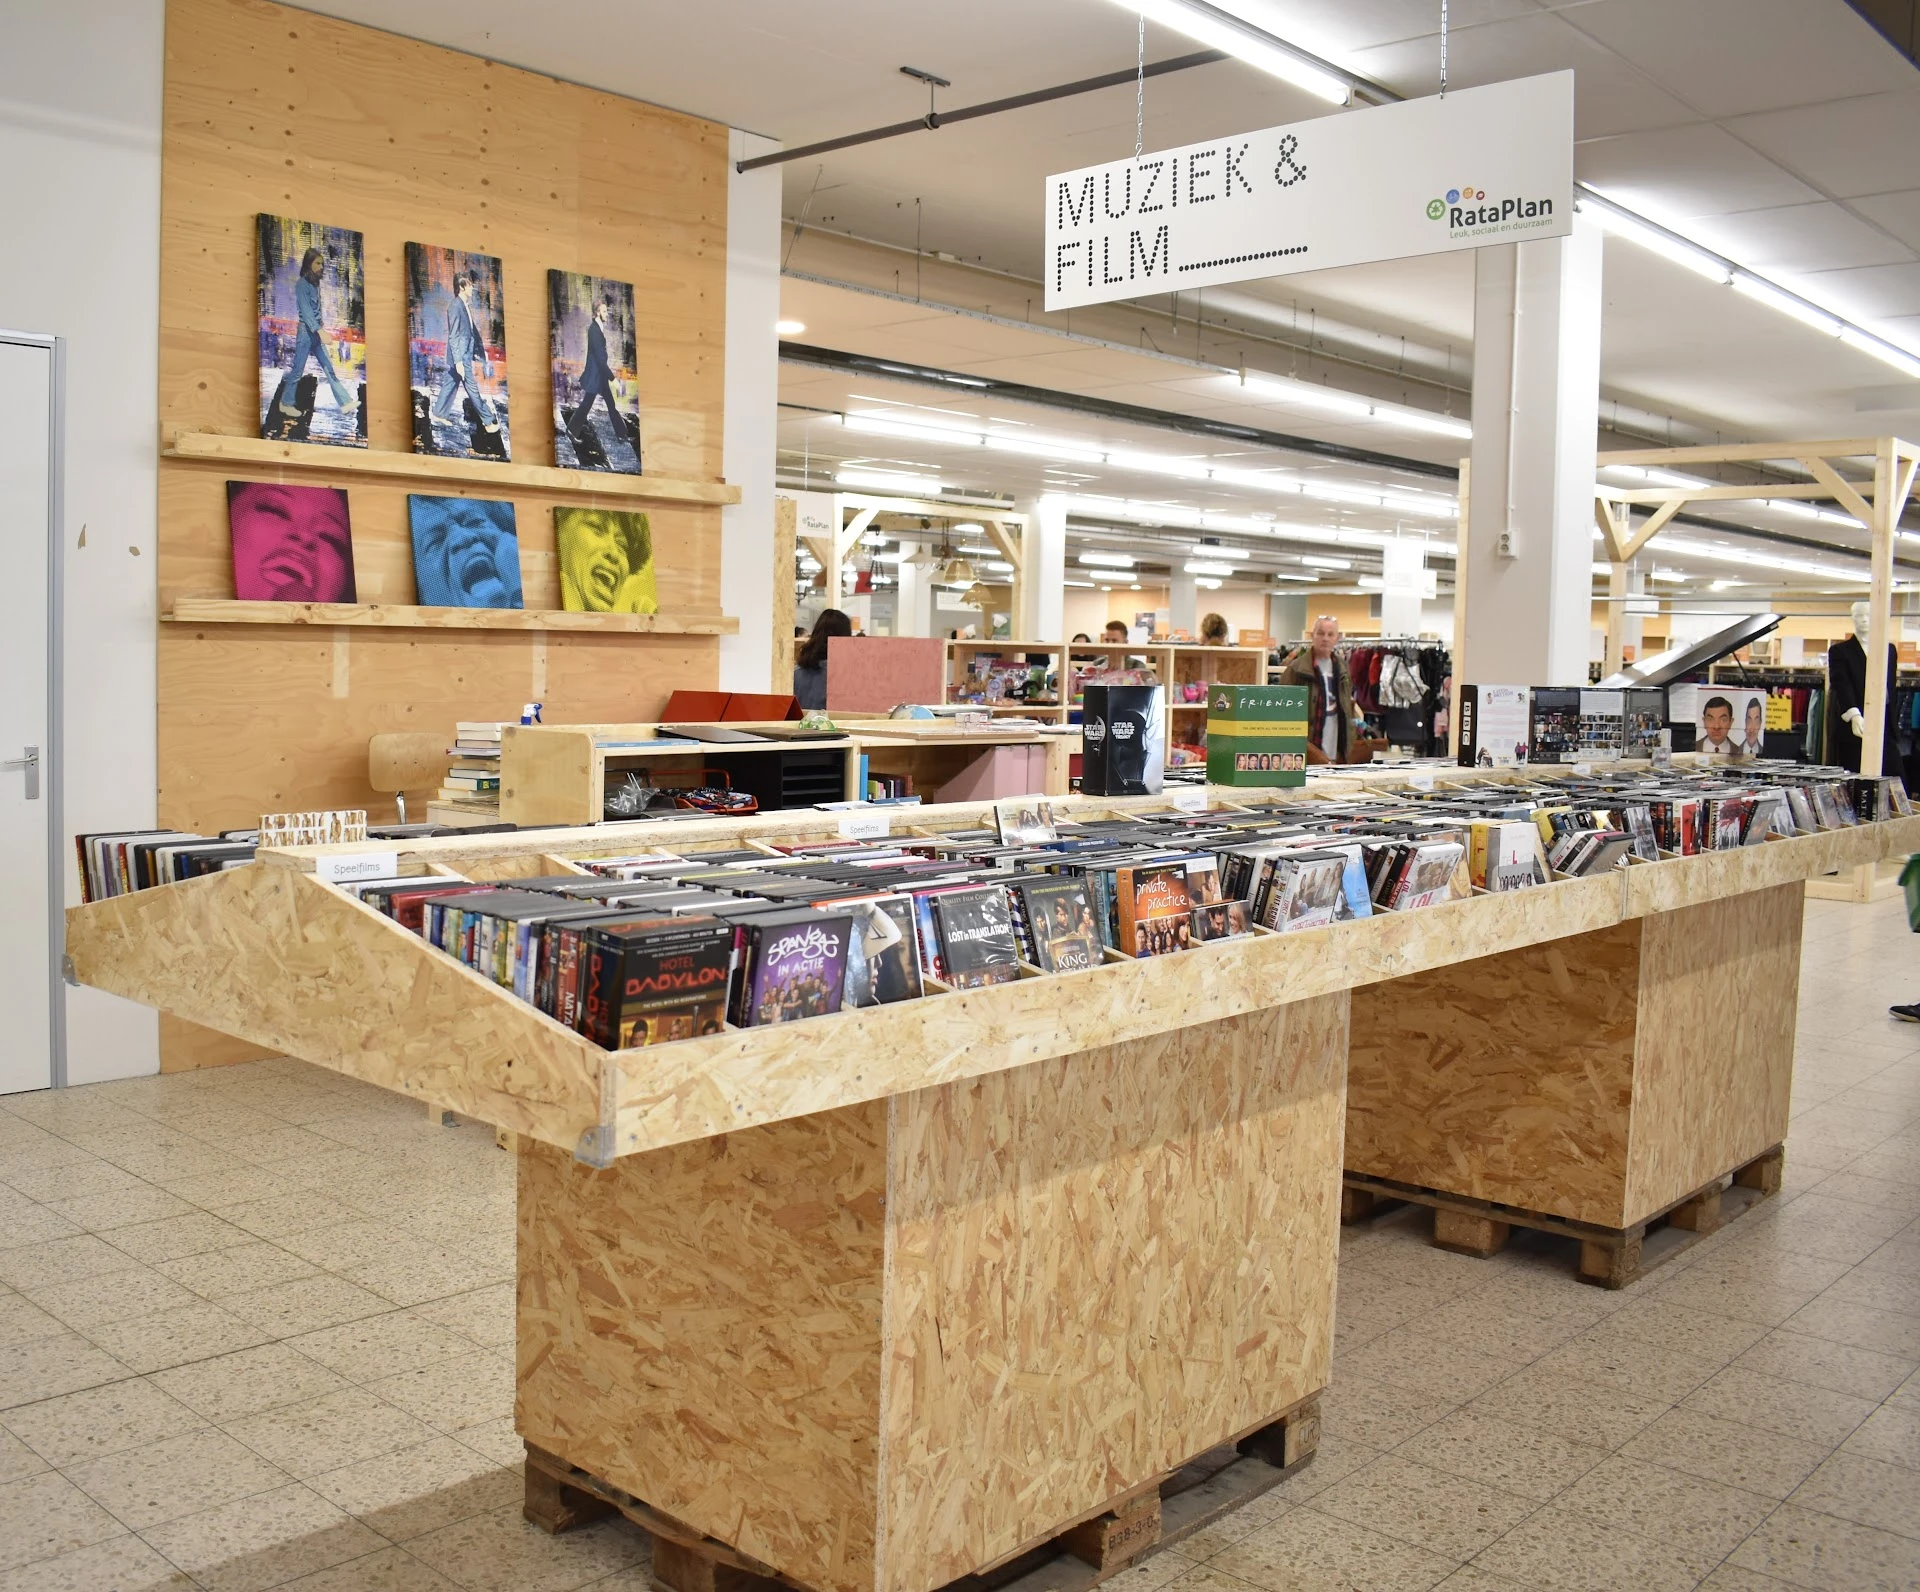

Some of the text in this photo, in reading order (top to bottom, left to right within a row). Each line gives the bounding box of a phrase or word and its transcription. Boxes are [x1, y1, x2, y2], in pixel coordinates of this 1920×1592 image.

[1058, 134, 1307, 229] MUZIEK &
[1450, 197, 1553, 228] RataPlan
[1449, 218, 1553, 239] Leuk, sociaal en duurzaam
[1057, 225, 1169, 292] FILM
[1111, 721, 1135, 729] STAR
[1463, 703, 1471, 744] BBC
[850, 824, 879, 835] Speelfilms
[333, 861, 381, 876] Speelfilms
[1136, 874, 1168, 904] private
[1401, 879, 1411, 893] LOL
[1147, 888, 1188, 919] practice
[947, 930, 964, 943] LOST
[967, 923, 1009, 940] TRANSLATION
[659, 956, 695, 971] HOTEL
[777, 957, 824, 978] IN ACTIE
[1057, 953, 1088, 969] KING
[625, 966, 727, 997] BABYLON
